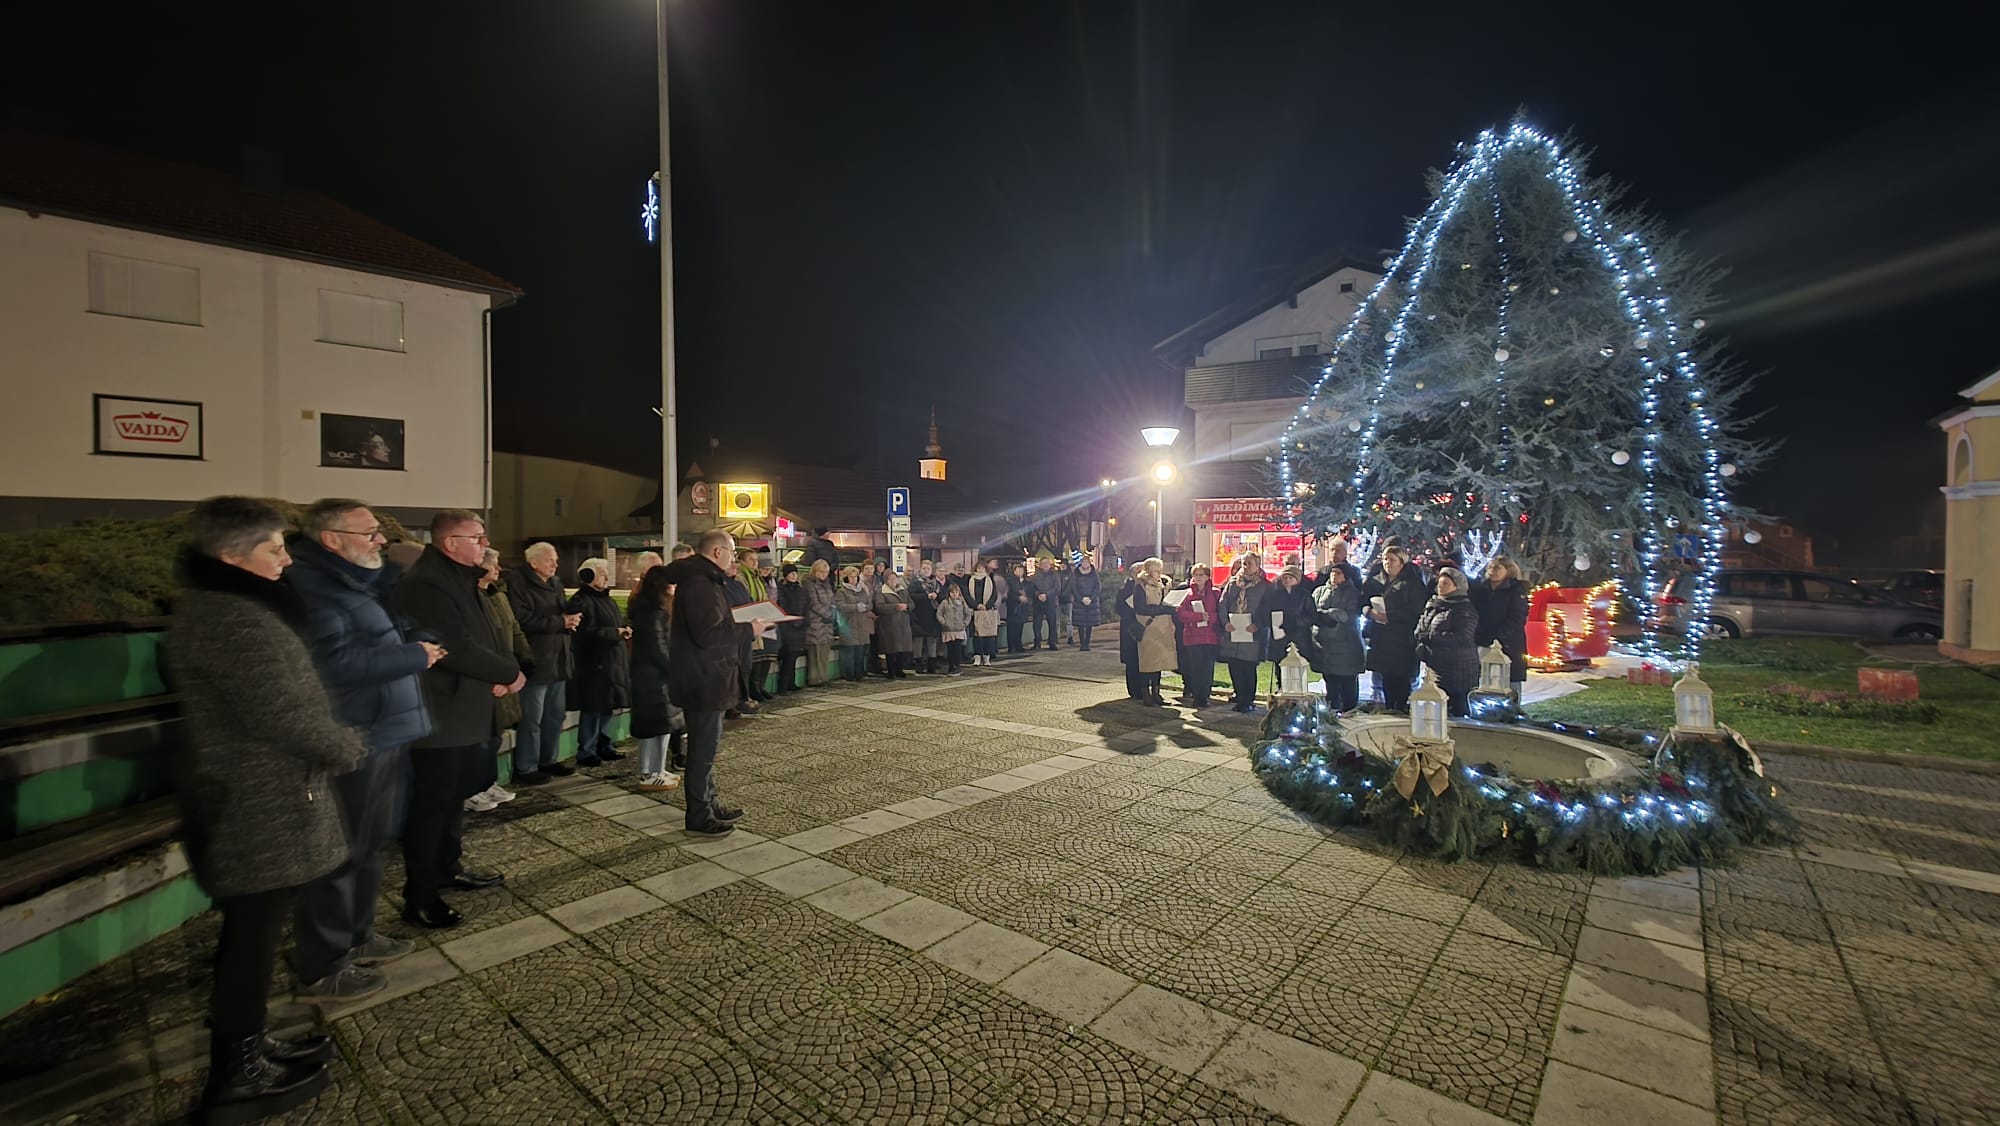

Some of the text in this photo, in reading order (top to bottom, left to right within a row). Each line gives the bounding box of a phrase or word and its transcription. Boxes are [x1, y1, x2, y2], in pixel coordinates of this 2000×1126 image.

[120, 422, 179, 437] VAJDA
[892, 492, 904, 512] P
[1213, 511, 1243, 522] PILIĆI
[893, 535, 905, 543] WC
